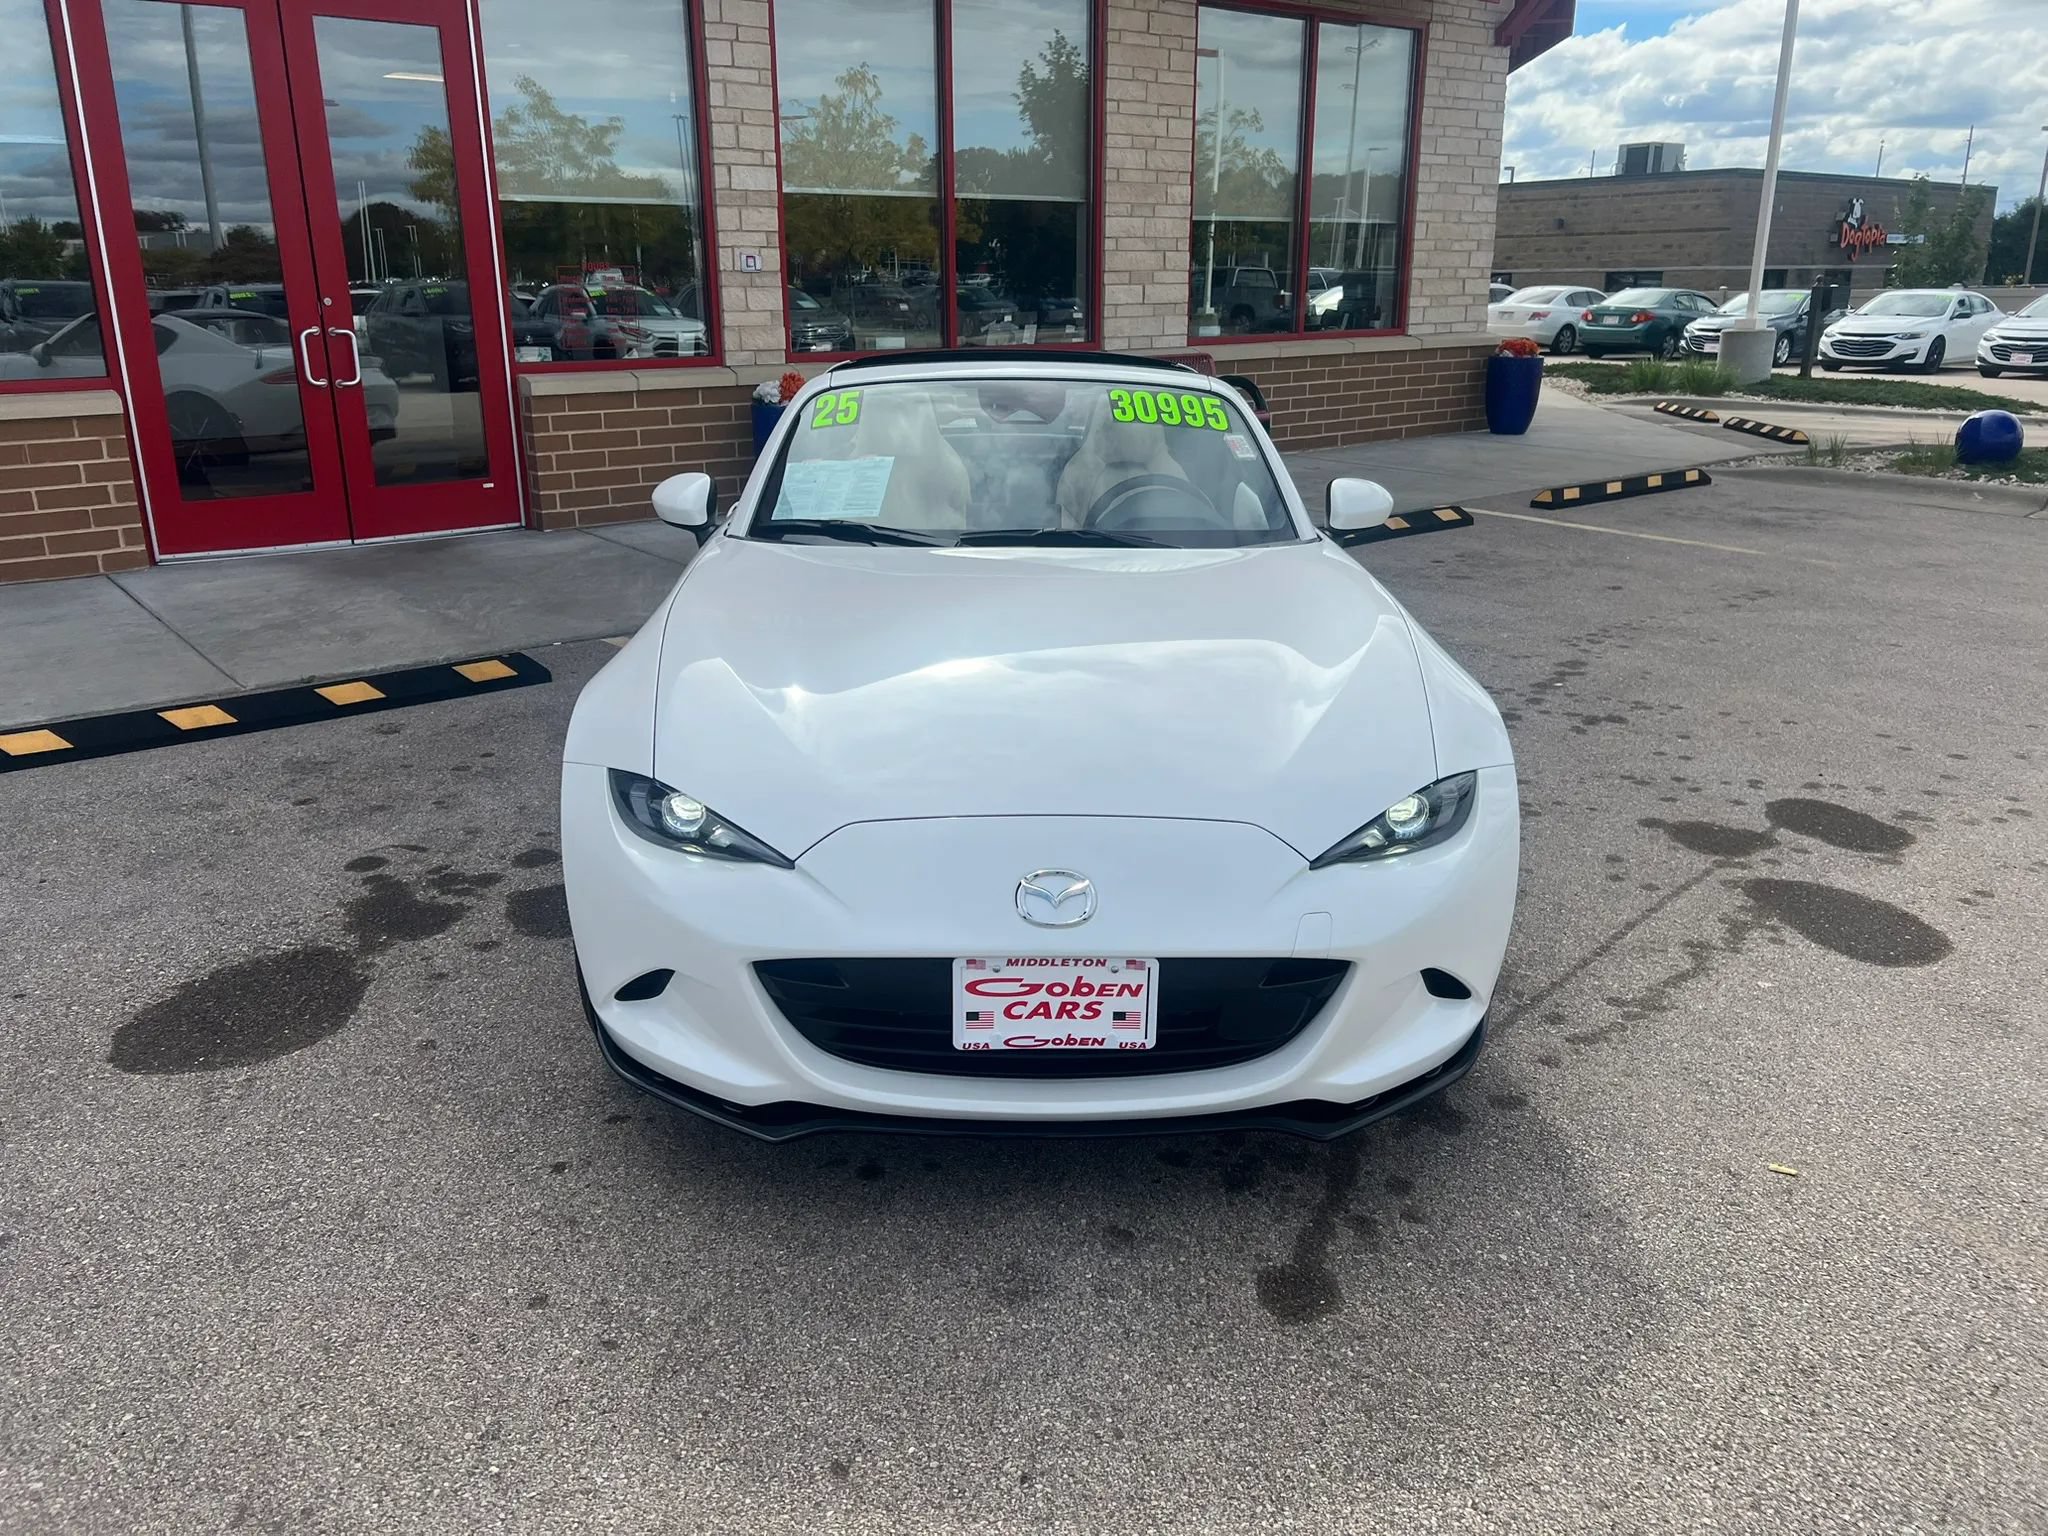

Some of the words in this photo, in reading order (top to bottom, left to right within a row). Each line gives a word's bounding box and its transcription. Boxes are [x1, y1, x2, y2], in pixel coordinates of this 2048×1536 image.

[812, 391, 860, 428] 25
[1109, 389, 1229, 431] 30995
[1006, 958, 1107, 967] MIDDLETON
[1003, 1001, 1104, 1020] CARS
[962, 1042, 990, 1050] USA
[1119, 1041, 1147, 1049] USA
